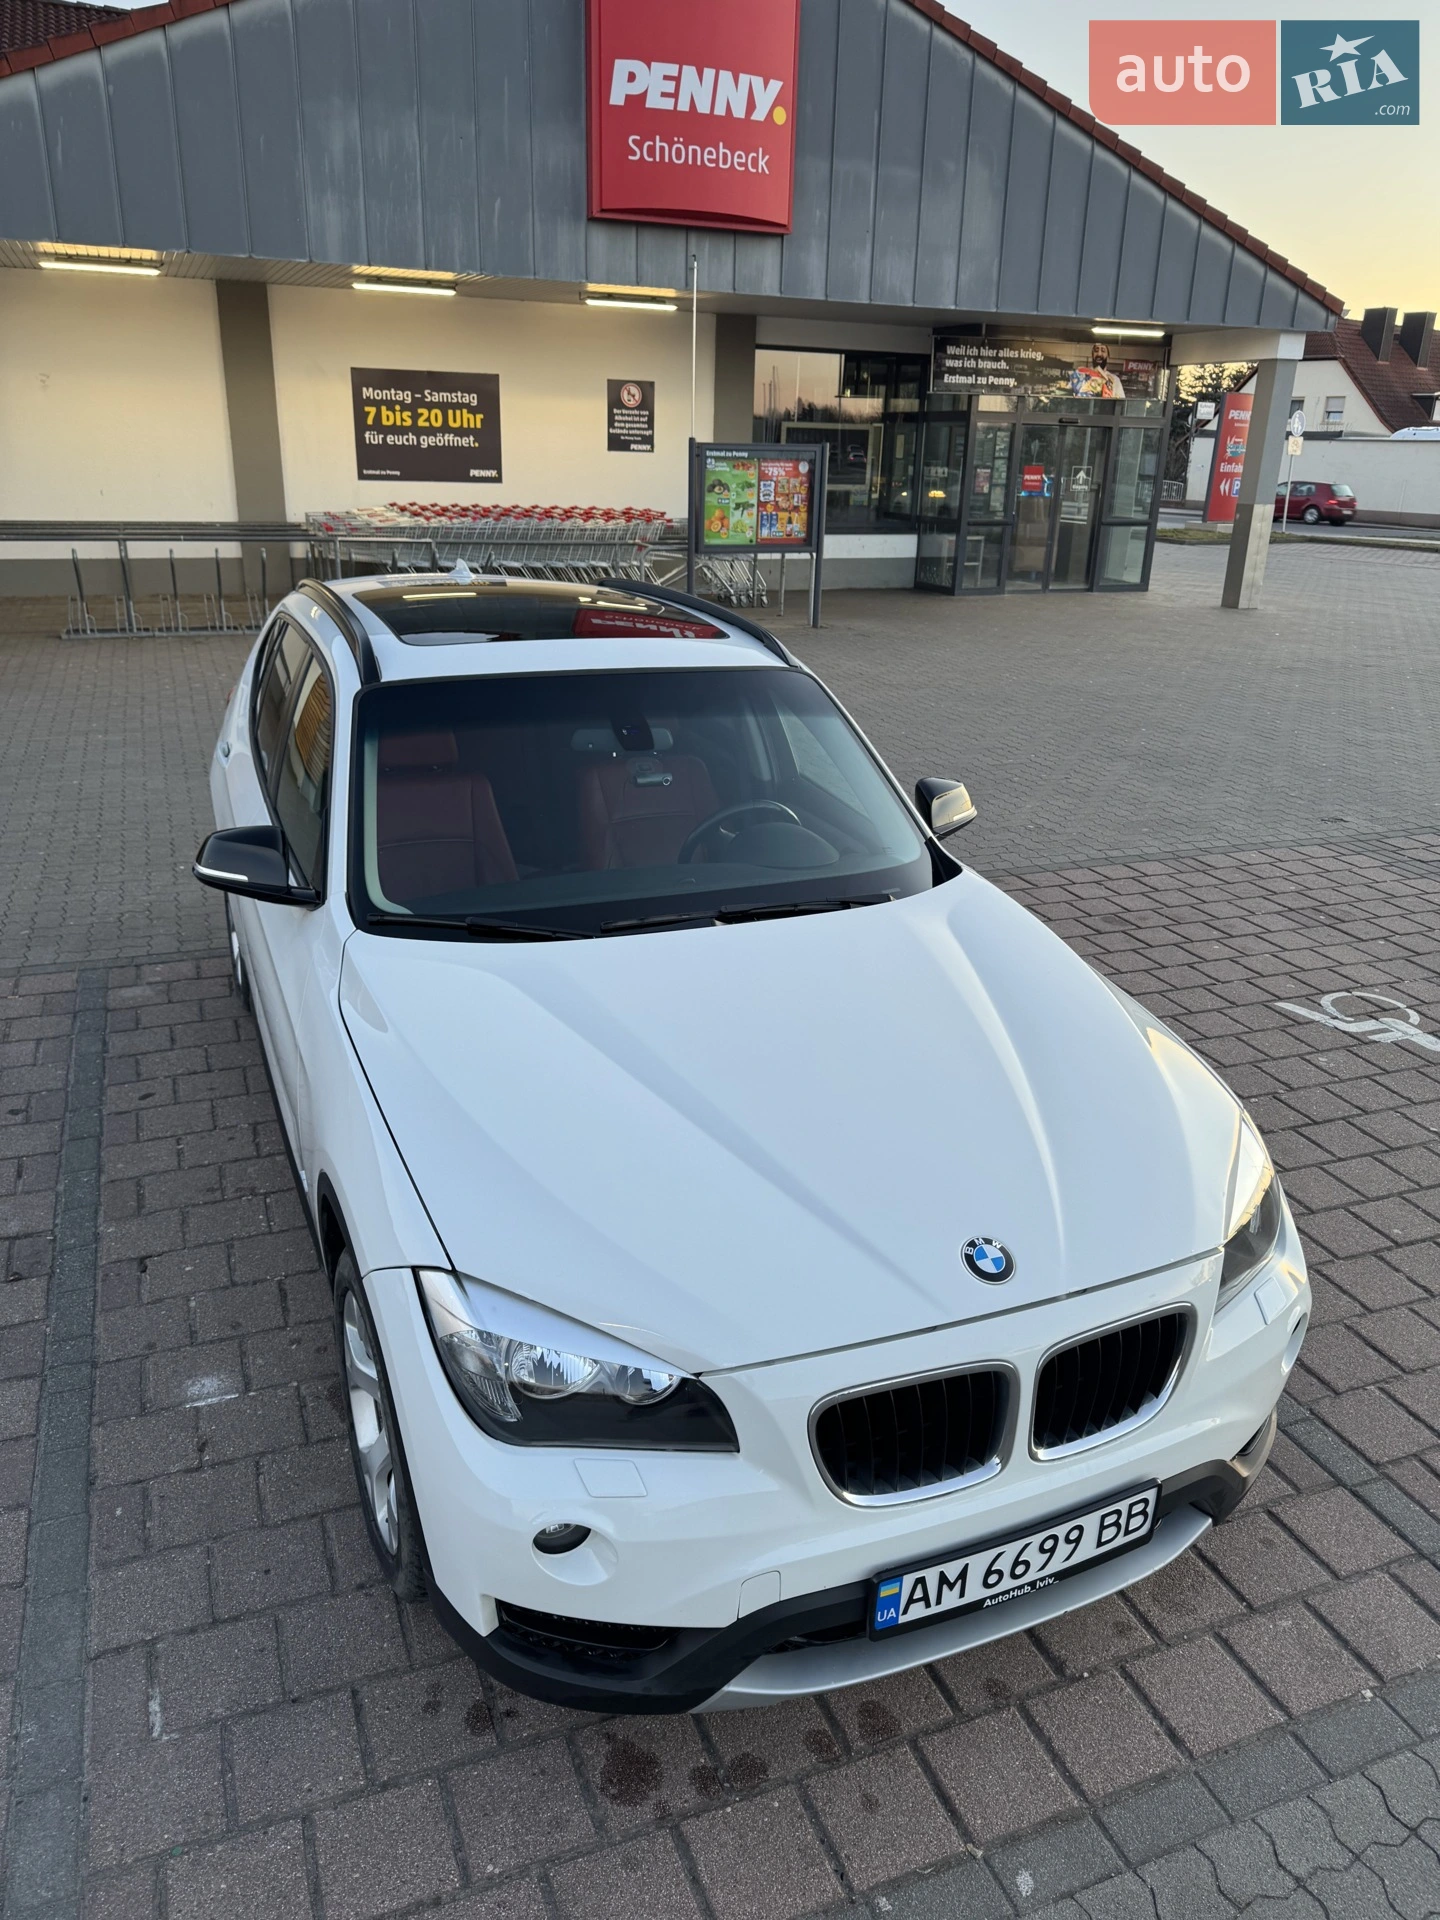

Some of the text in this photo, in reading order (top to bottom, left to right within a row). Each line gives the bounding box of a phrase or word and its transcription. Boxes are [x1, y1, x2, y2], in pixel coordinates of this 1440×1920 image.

[609, 58, 787, 126] PENNY.
[628, 134, 770, 175] Schönebeck
[946, 345, 1044, 360] Weil ich hier alles krieg,
[945, 358, 1009, 370] was ich brauch.
[944, 374, 1018, 387] Erstmal zu Penny.
[362, 387, 412, 404] Montag
[424, 389, 478, 406] Samstag
[364, 404, 484, 429] 7 bis 20 Uhr
[1229, 409, 1251, 420] PENN
[364, 431, 479, 448] für euch geöffnet.
[877, 1497, 1150, 1623] UA AM 6699 BB
